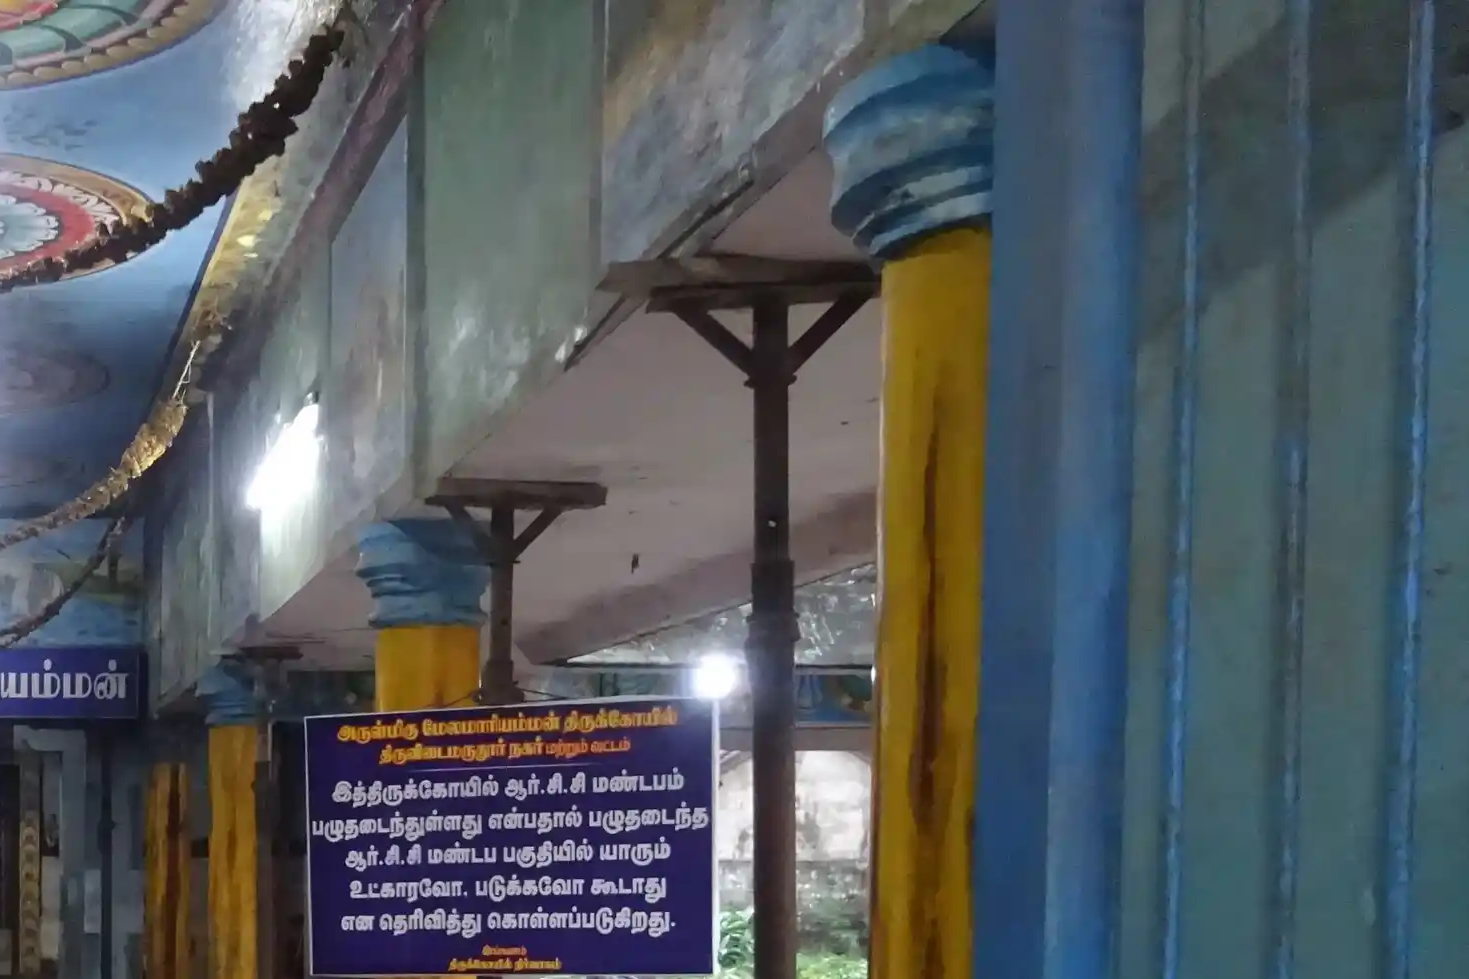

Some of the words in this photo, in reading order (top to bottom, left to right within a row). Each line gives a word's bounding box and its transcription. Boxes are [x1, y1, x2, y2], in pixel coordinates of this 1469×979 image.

[336, 719, 418, 746] அருள்மிகு
[564, 706, 677, 735] திருக்கோயில்
[508, 736, 543, 759] நகர்
[545, 740, 589, 759] மற்றும்
[590, 738, 630, 753] வட்டம்
[331, 776, 499, 808] இத்திருக்கோயில்
[504, 771, 585, 801] ஆர்.சி.சி
[592, 768, 684, 793] மண்டபம்
[312, 810, 483, 842] பழுதடைந்துள்ளது
[489, 805, 583, 832] என்பதால்
[589, 801, 709, 831] பழுதடைந்த
[345, 843, 422, 870] ஆர்.சி.சி
[428, 842, 496, 864] மண்டப
[502, 838, 593, 867] பகுதியில்
[599, 837, 670, 866] யாரும்
[476, 874, 584, 902] படுக்கவோ
[590, 876, 667, 903] கூடாது
[341, 913, 374, 932] என
[379, 911, 481, 938] தெரிவித்து
[487, 908, 676, 938] கொள்ளப்படுகிறது.
